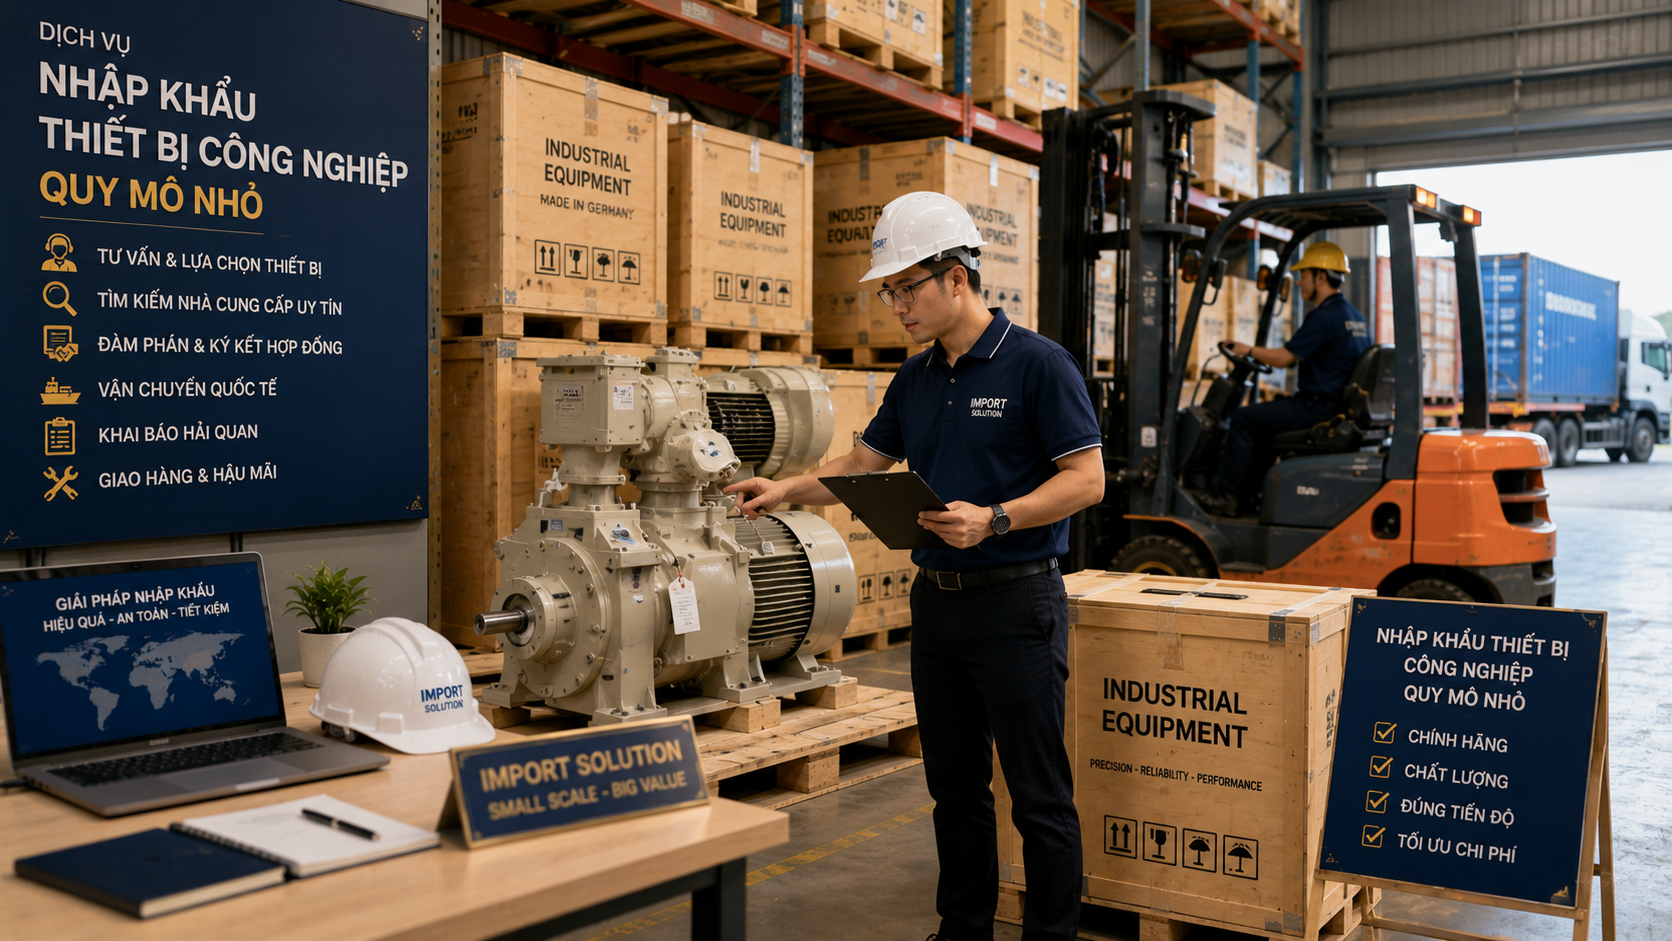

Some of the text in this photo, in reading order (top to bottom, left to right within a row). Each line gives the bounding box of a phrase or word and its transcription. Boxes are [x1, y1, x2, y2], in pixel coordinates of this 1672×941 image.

[40, 21, 130, 58] DỊCH VỤ
[40, 61, 256, 122] NHẬP KHẨU
[39, 115, 408, 193] THIẾT BỊ CÔNG NGHIỆP
[546, 138, 631, 172] INDUSTRIAL
[544, 163, 631, 196] EQUIPMENT
[40, 170, 264, 220] QUY MÔ NHỎ
[540, 194, 634, 220] MADE IN GERMANY
[721, 191, 786, 218] INDUSTRIAL
[720, 212, 786, 238] EQUIPMENT
[828, 205, 886, 224] INDUSTR
[97, 246, 322, 279] TƯ VẤN & LỰA CHỌN THIẾT BỊ
[97, 288, 342, 316] TÌM KIẾM NHÀ CUNG CẤP UY TÍN
[97, 332, 138, 352] ĐÀM
[144, 334, 188, 352] PHÁN
[194, 338, 205, 353] &
[210, 336, 230, 354] KÝ
[234, 334, 262, 354] KẾT
[268, 339, 298, 357] HỢP
[98, 378, 133, 401] VẬN
[210, 376, 255, 398] QUỐC
[259, 376, 277, 396] TẾ
[970, 398, 1008, 410] IMPORT
[970, 410, 1002, 418] SOLUTION
[99, 420, 258, 443] KHAI BÁO HẢI QUAN
[99, 462, 277, 488] GIAO HÀNG & HẬU MÃI
[91, 589, 130, 607] PHÁP
[134, 586, 174, 604] NHẬP
[44, 616, 74, 633] HIỆU
[117, 612, 134, 624] AN
[1376, 626, 1570, 661] NHẬP KHẨU THIẾT BỊ
[1404, 654, 1534, 686] CÔNG NGHIỆP
[420, 684, 463, 702] IMPORT
[424, 700, 463, 713] SOLUTION
[1104, 678, 1248, 715] INDUSTRIAL
[1404, 684, 1526, 712] QUY MÔ NHỎ
[1102, 709, 1248, 749] EQUIPMENT
[1408, 728, 1508, 753] CHÍNH HÃNG
[480, 740, 683, 792] IMPORT SOLUTION
[1090, 758, 1132, 773] PRECISION
[1140, 766, 1189, 781] RELIABILITY
[1197, 774, 1262, 792] PERFORMANCE
[1404, 762, 1508, 789] CHẤT LƯỢNG
[488, 770, 687, 820] SMALL SCALE - BIG VALUE
[1400, 796, 1514, 829] ĐÚNG TIẾN ĐỘ
[1398, 831, 1518, 864] TỐI ƯU CHI PHÍ
